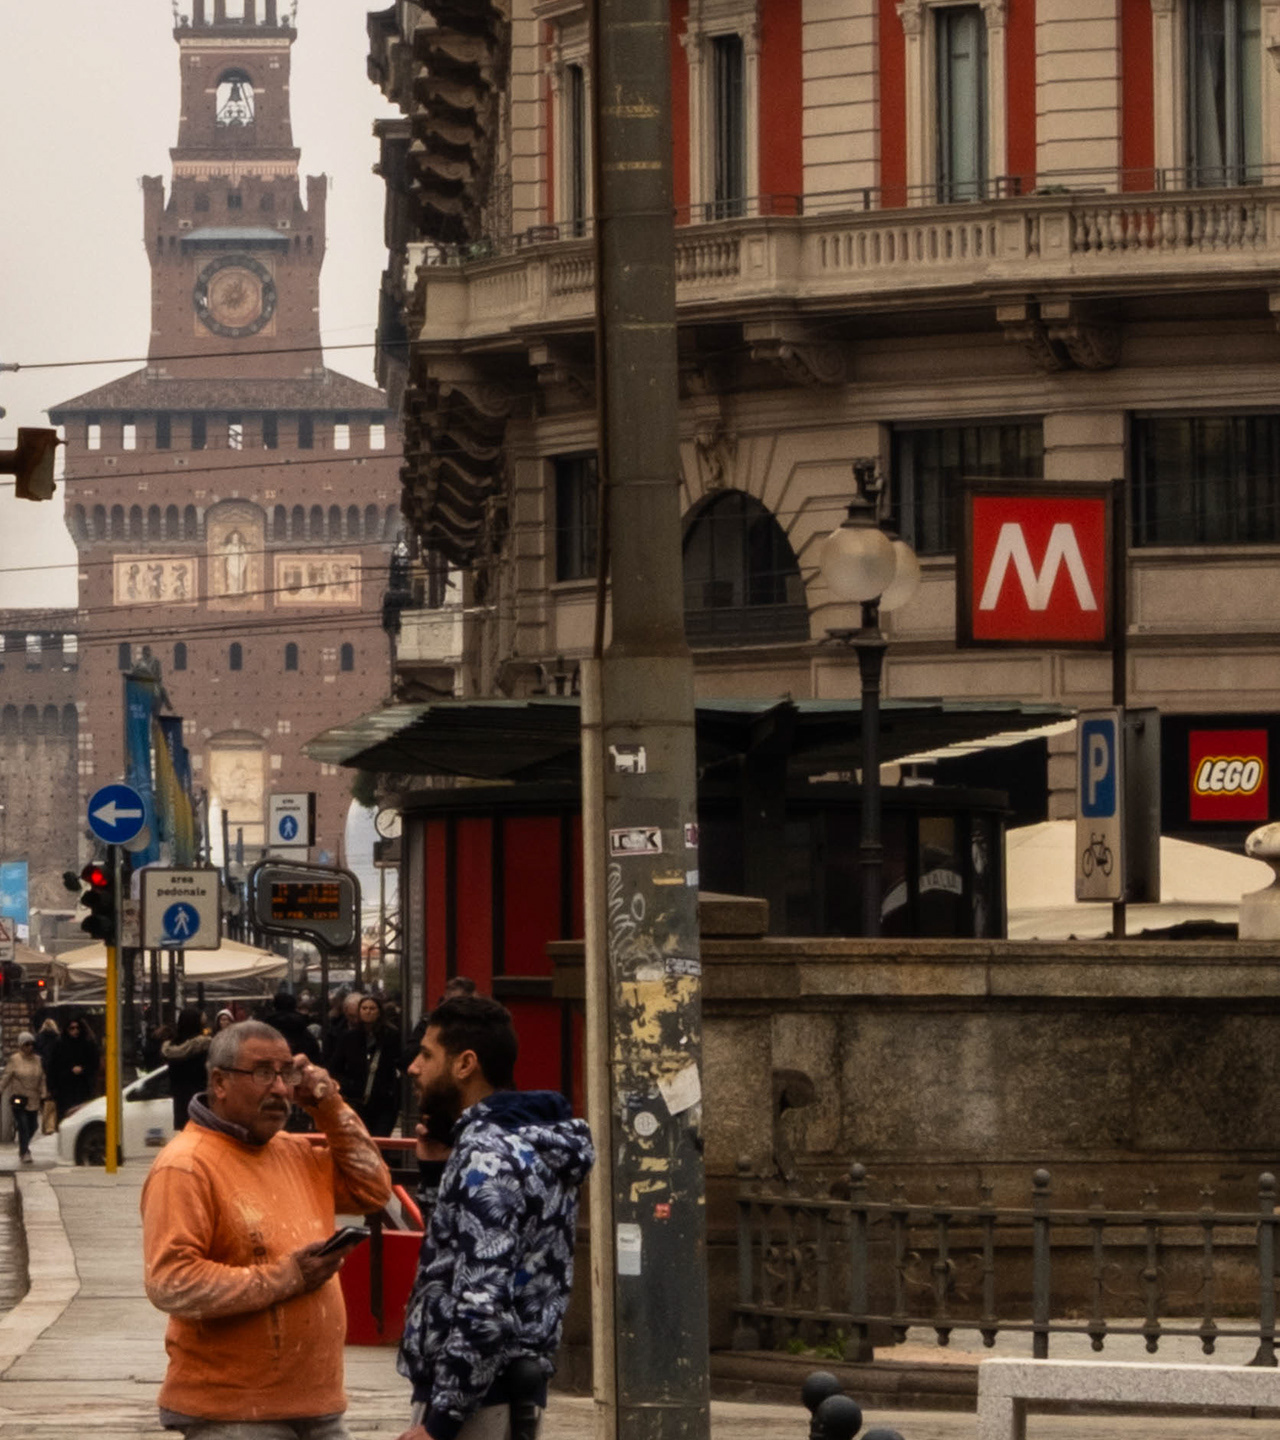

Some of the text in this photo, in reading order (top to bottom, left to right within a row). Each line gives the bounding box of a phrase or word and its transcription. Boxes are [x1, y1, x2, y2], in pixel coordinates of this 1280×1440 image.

[978, 522, 1098, 611] M
[1088, 733, 1109, 806] P
[1197, 759, 1261, 792] LEGO
[156, 887, 207, 897] pedonale
[170, 876, 194, 884] area
